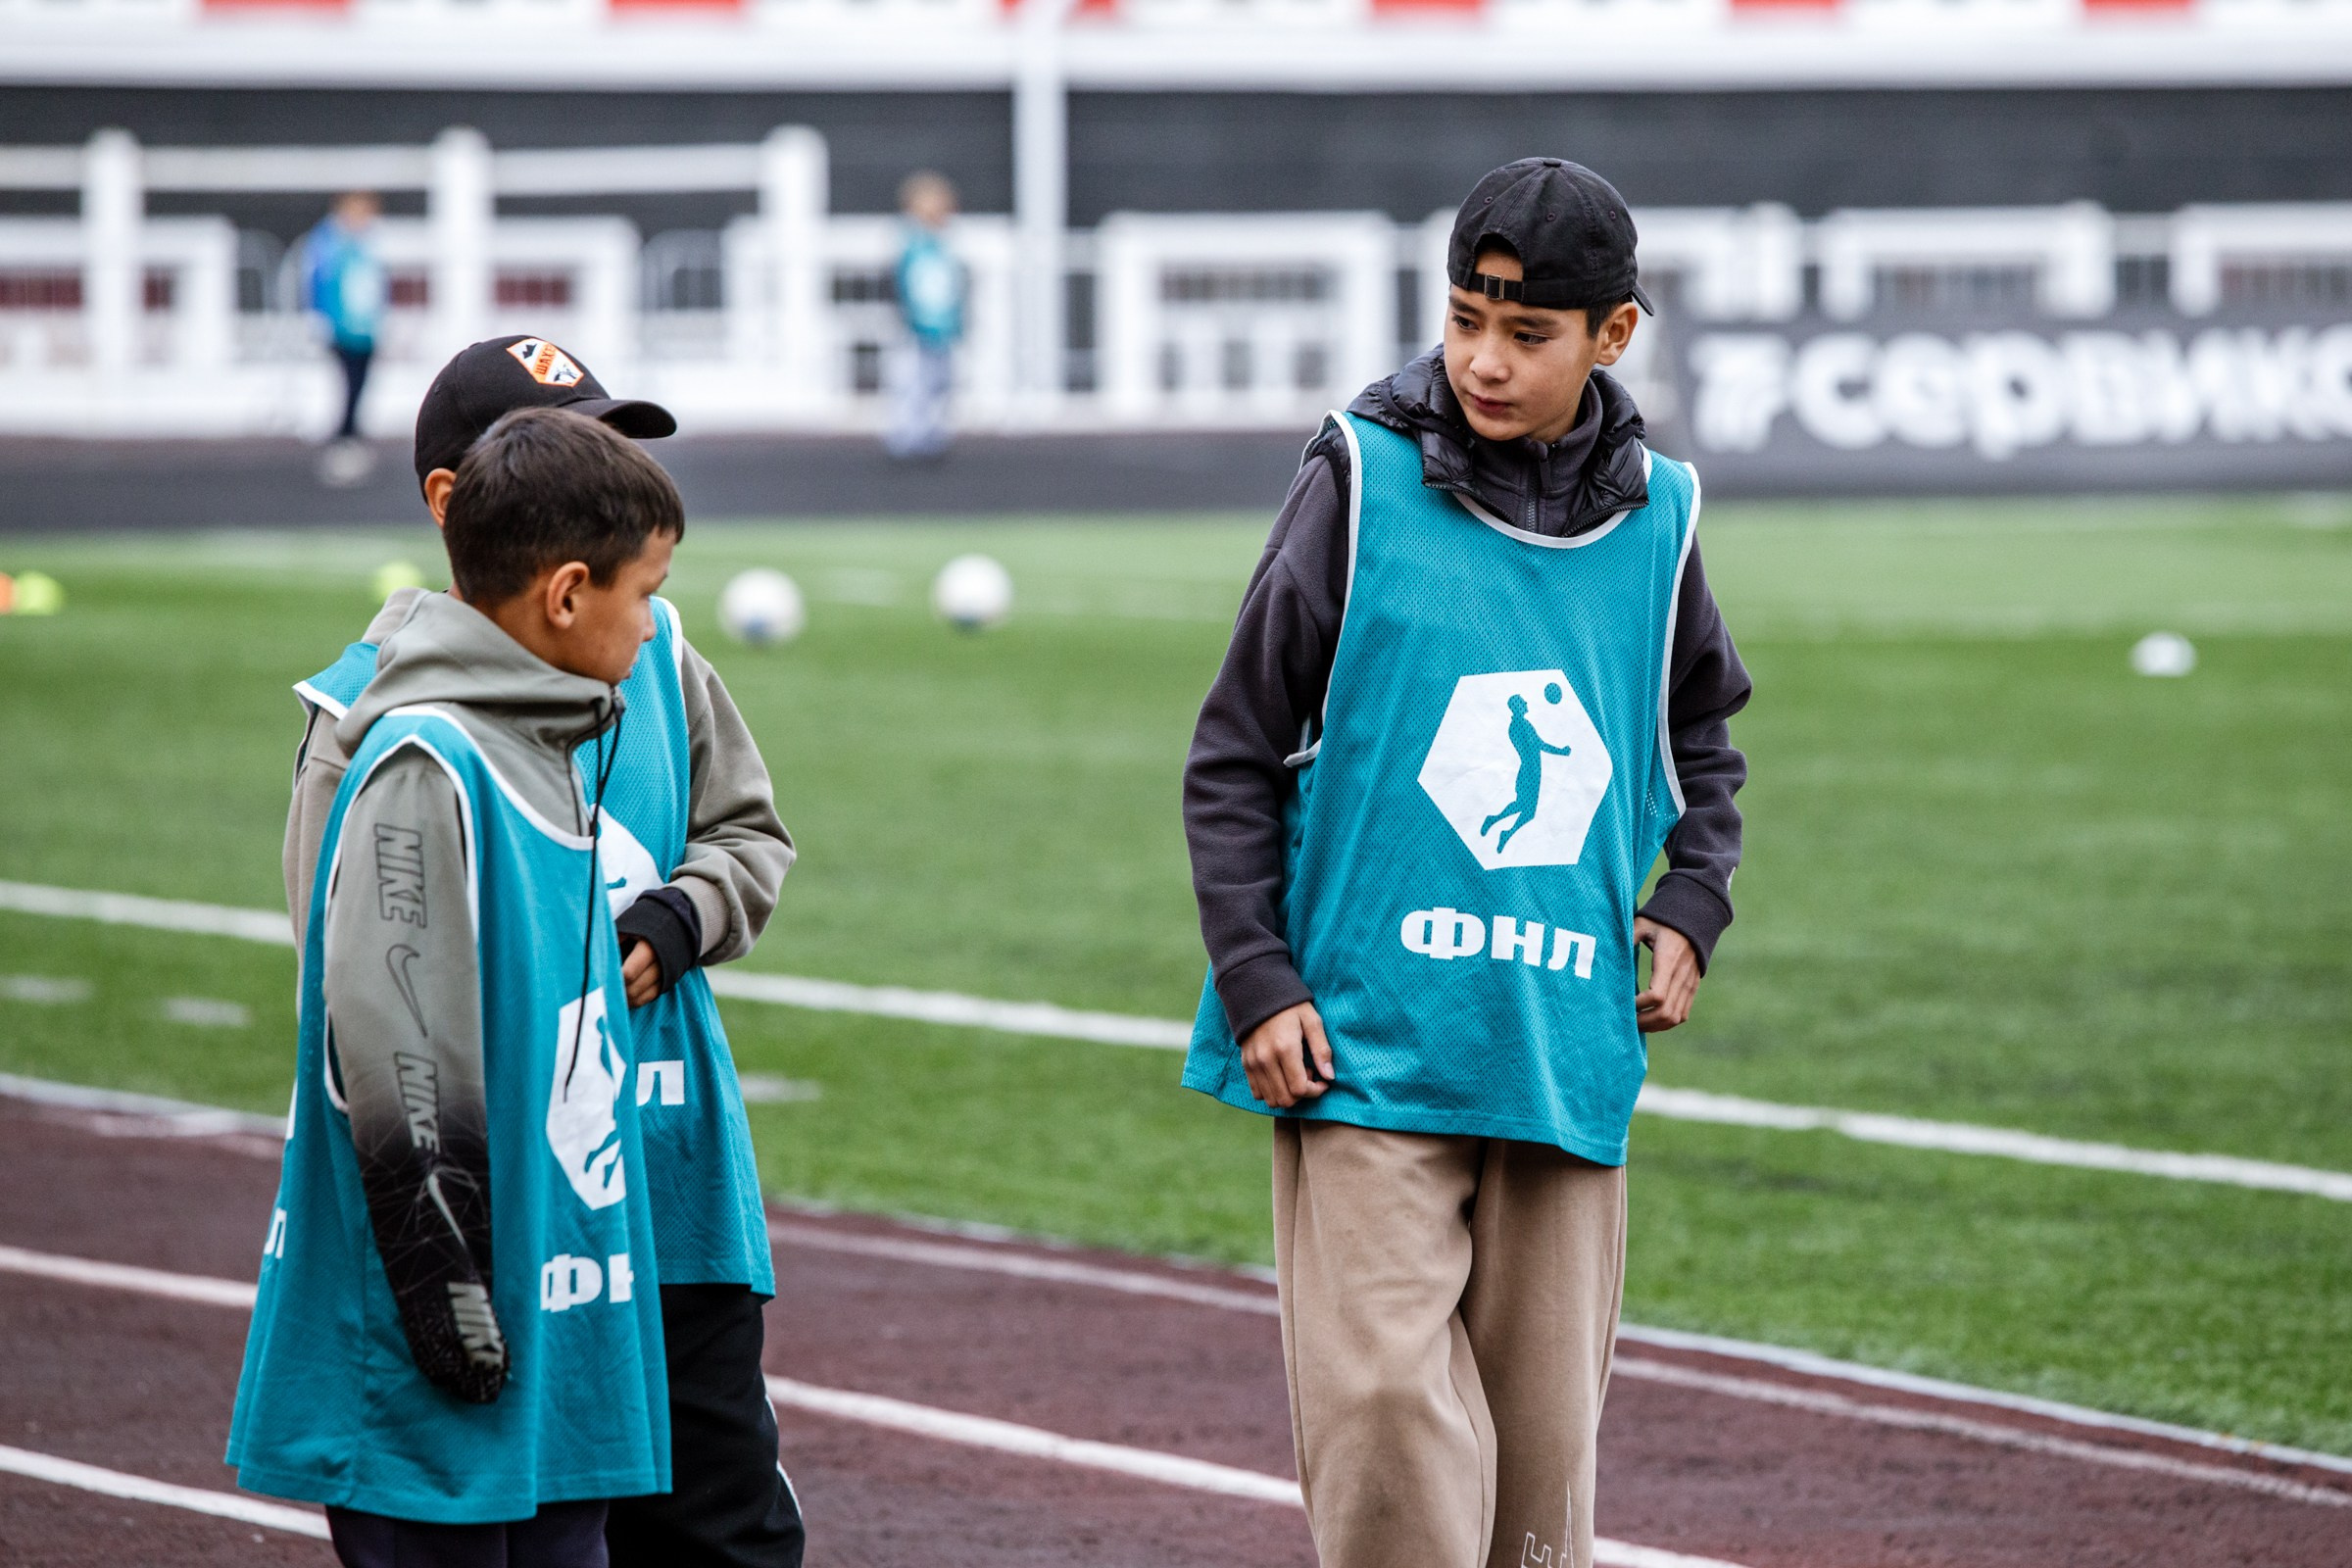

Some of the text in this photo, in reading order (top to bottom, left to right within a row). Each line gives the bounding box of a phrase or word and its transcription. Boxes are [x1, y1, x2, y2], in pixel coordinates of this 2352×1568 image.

[373, 822, 427, 929] NIKE
[1400, 906, 1596, 980] ФНЛ
[394, 1052, 441, 1154] NIKE
